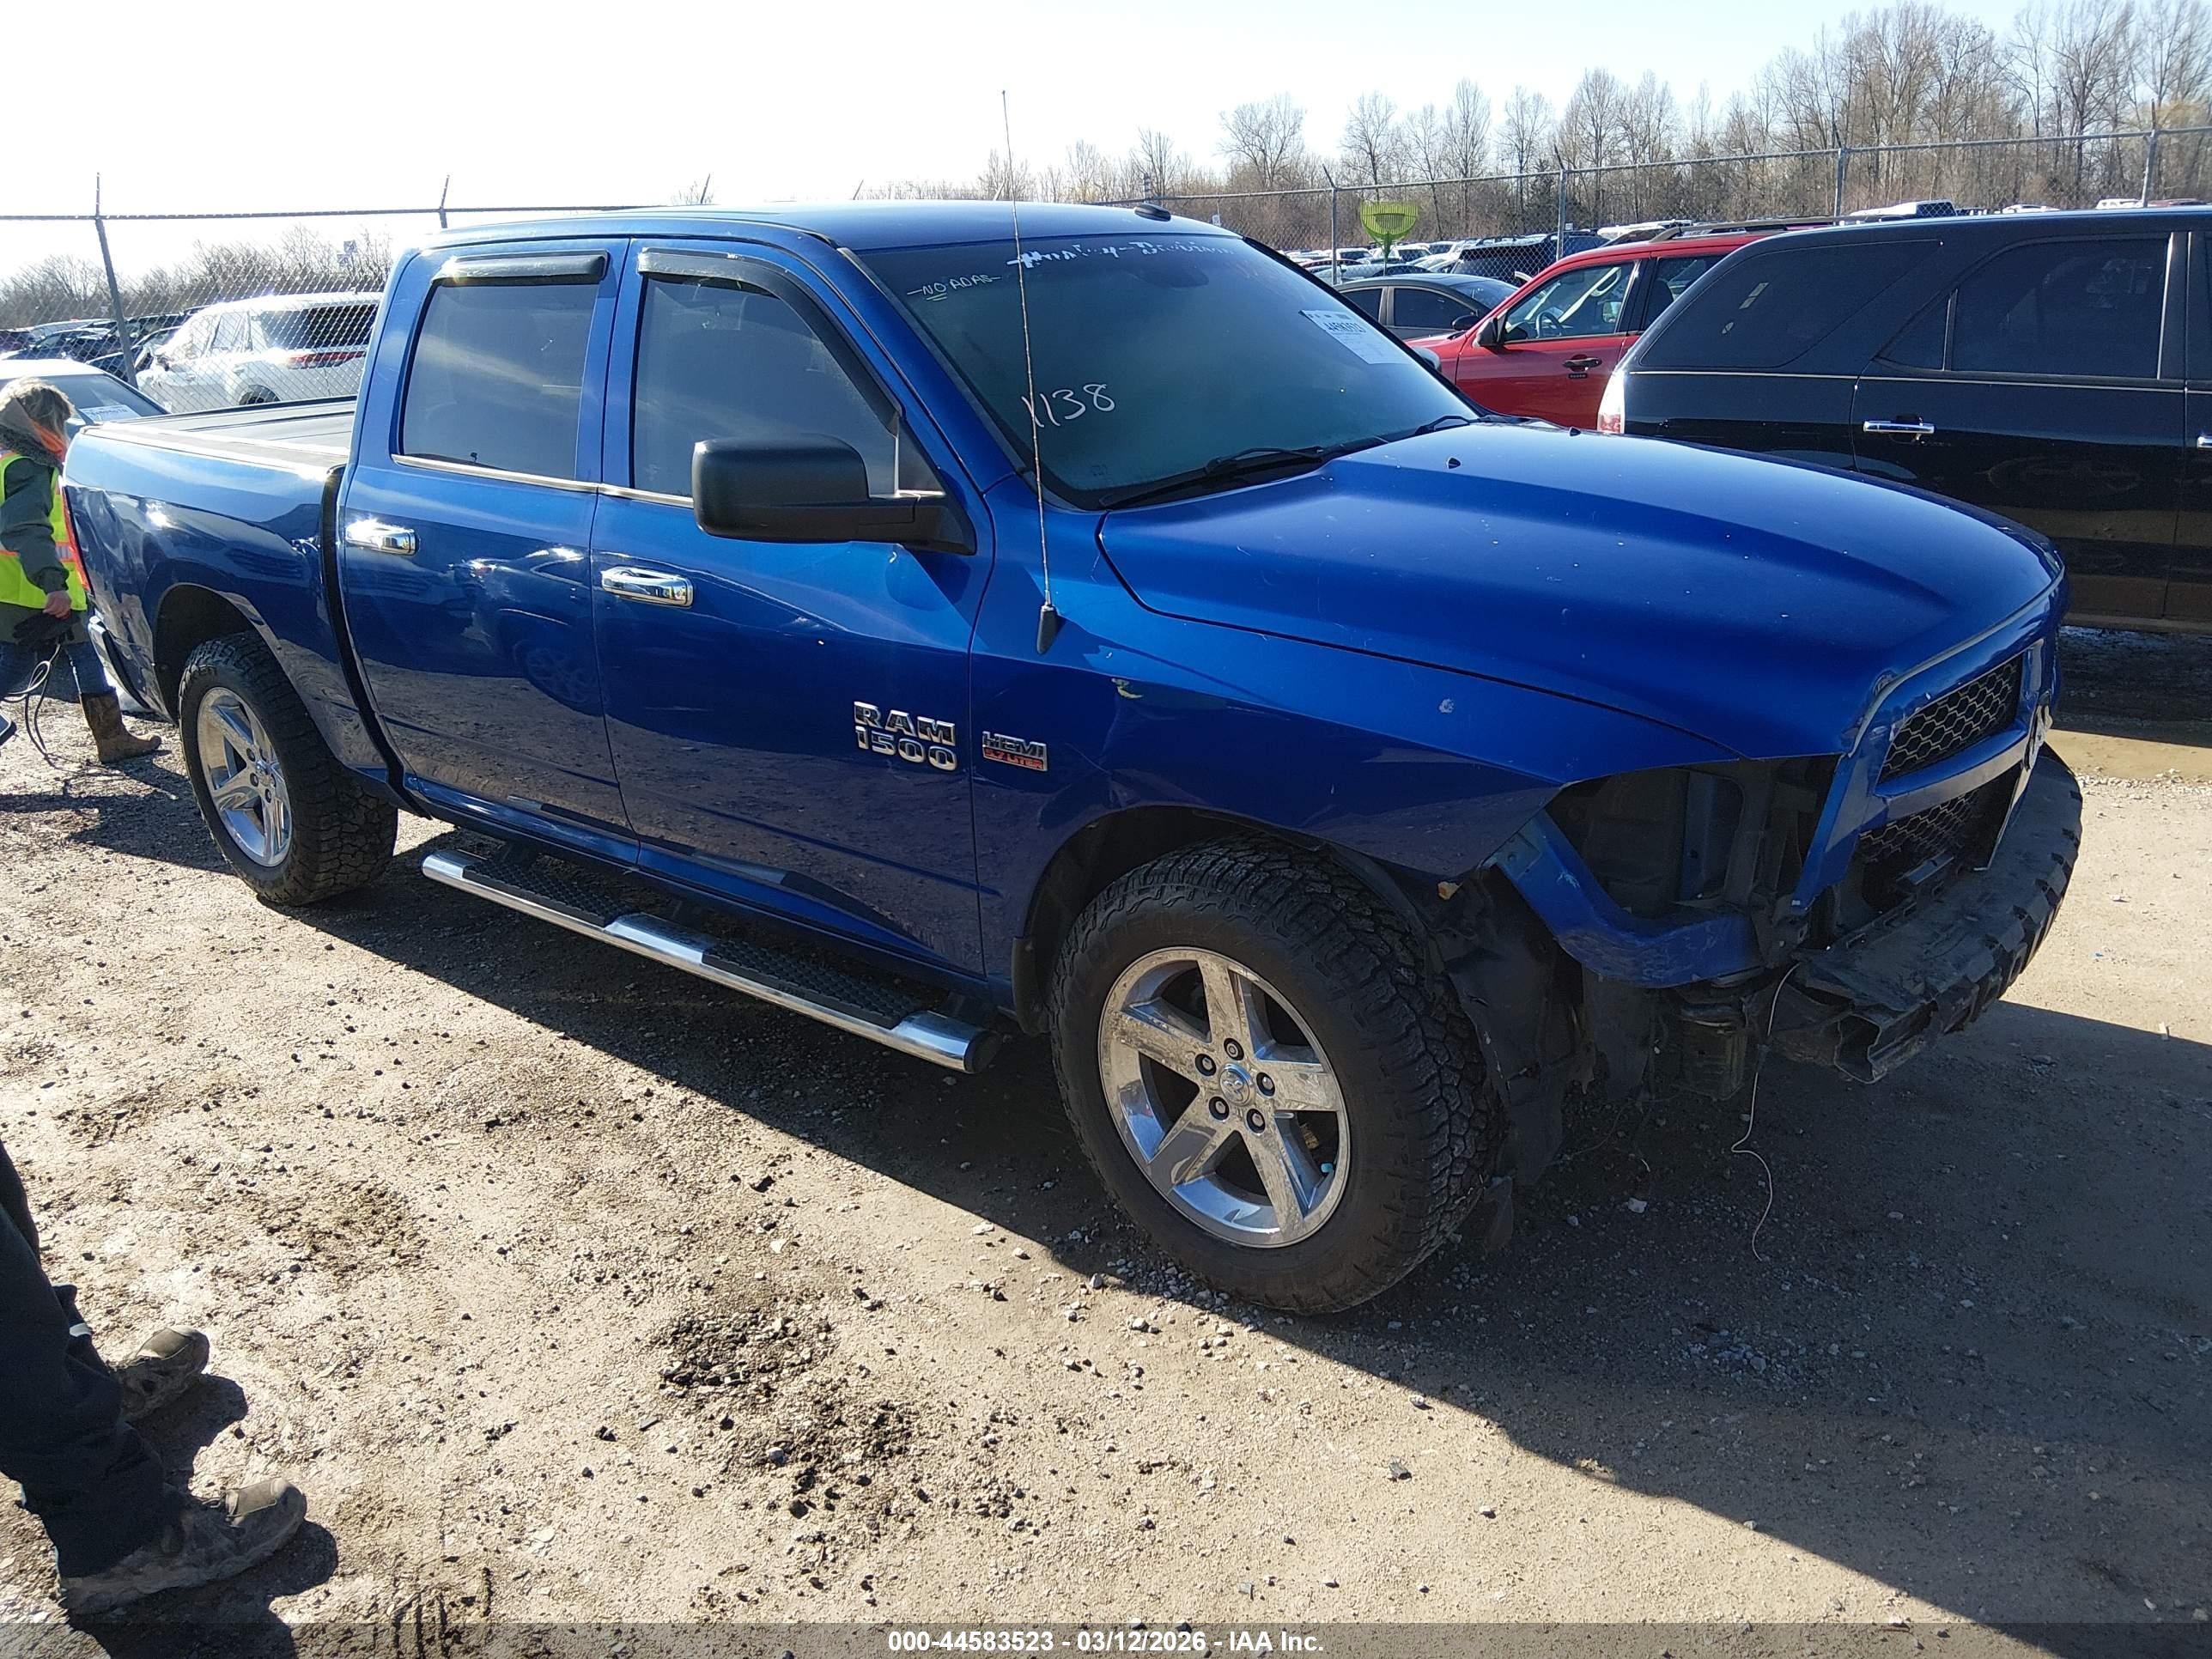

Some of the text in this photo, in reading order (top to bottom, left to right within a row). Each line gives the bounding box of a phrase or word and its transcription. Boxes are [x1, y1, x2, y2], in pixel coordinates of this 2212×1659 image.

[1021, 383, 1115, 428] 1138
[854, 701, 956, 746] RAM
[981, 731, 1047, 759] HEMI
[854, 726, 957, 771] 1500
